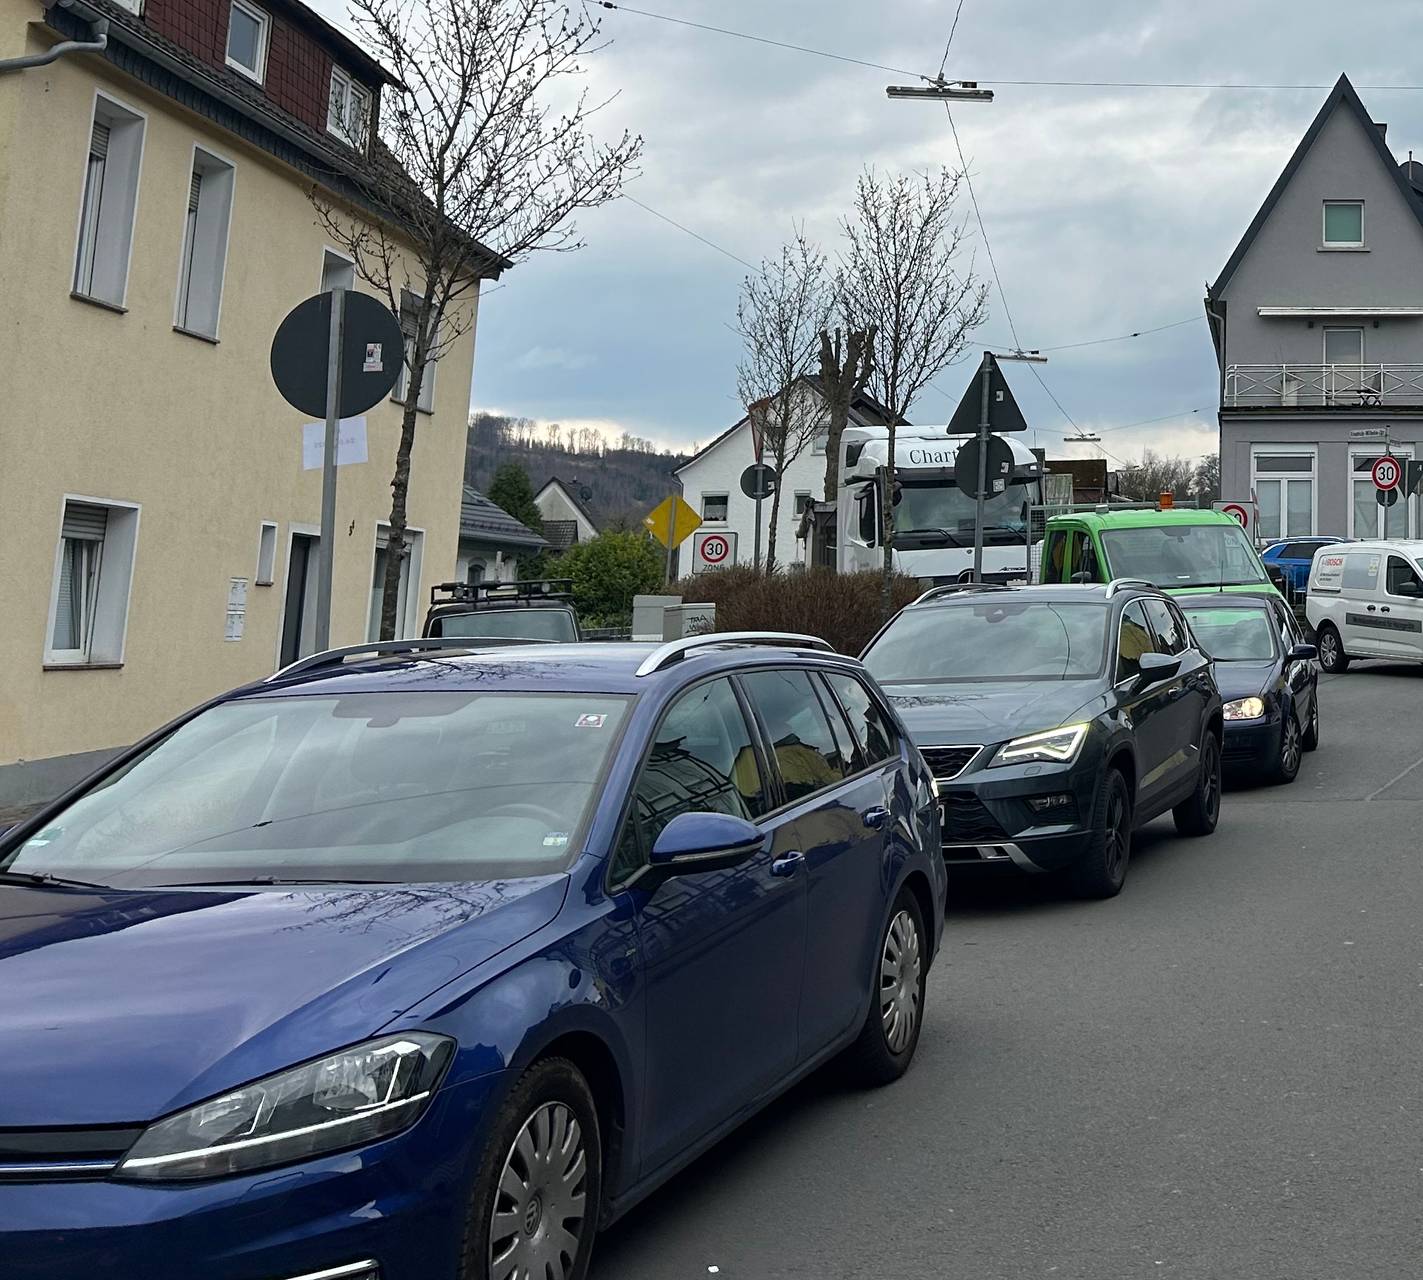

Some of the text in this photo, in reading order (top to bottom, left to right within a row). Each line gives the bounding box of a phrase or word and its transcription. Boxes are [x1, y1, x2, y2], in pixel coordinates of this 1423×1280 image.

[1377, 466, 1394, 481] 30
[706, 542, 723, 556] 30
[1327, 557, 1344, 566] BOSCH
